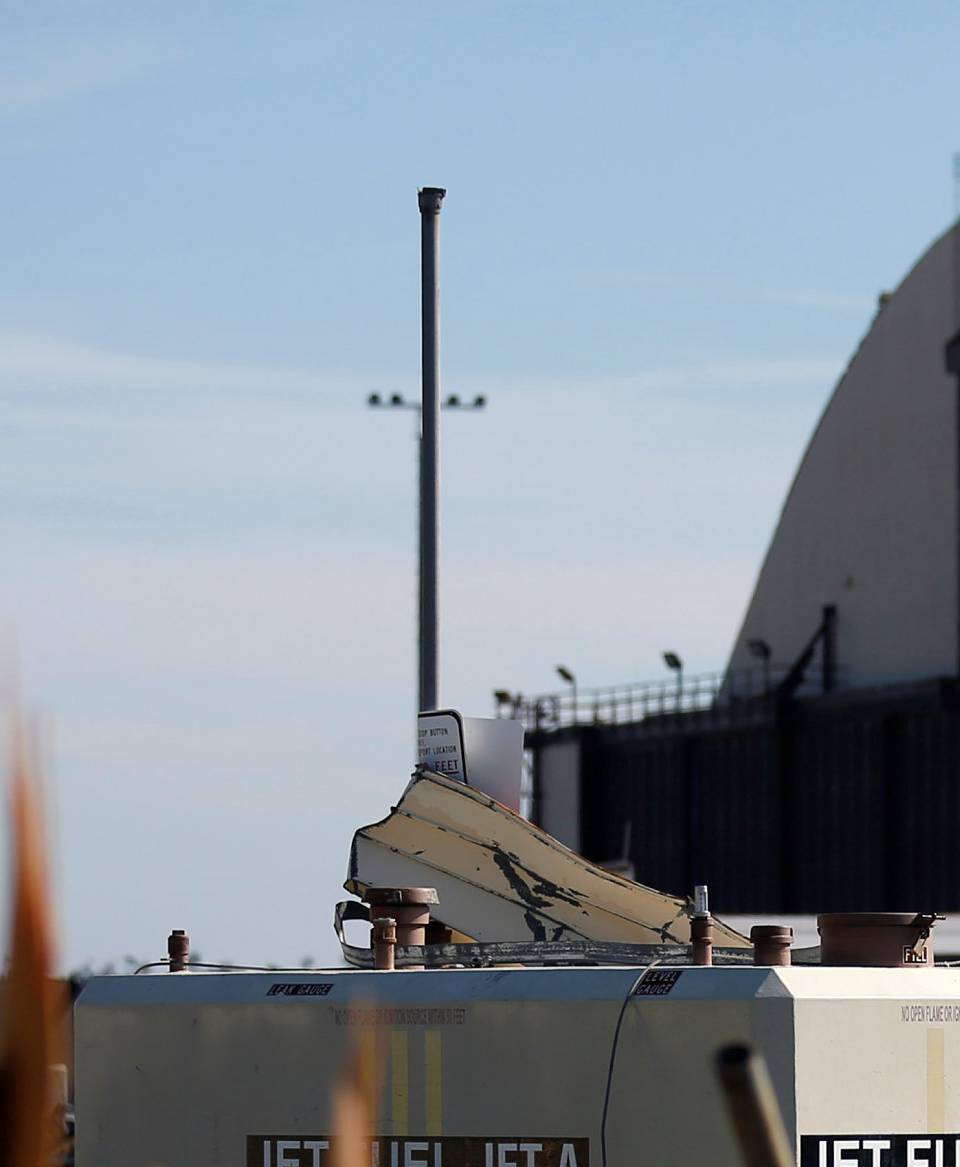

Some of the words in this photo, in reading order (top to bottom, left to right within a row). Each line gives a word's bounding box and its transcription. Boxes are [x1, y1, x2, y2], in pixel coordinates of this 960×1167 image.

[430, 728, 448, 737] BUTTON
[433, 745, 457, 755] LOCATION
[435, 760, 458, 770] FEET
[645, 971, 677, 982] LEVEL
[636, 984, 673, 994] GAUGE
[901, 1006, 909, 1021] NO
[910, 1006, 924, 1021] OPEN
[926, 1006, 943, 1021] FLAME
[944, 1006, 952, 1021] OR
